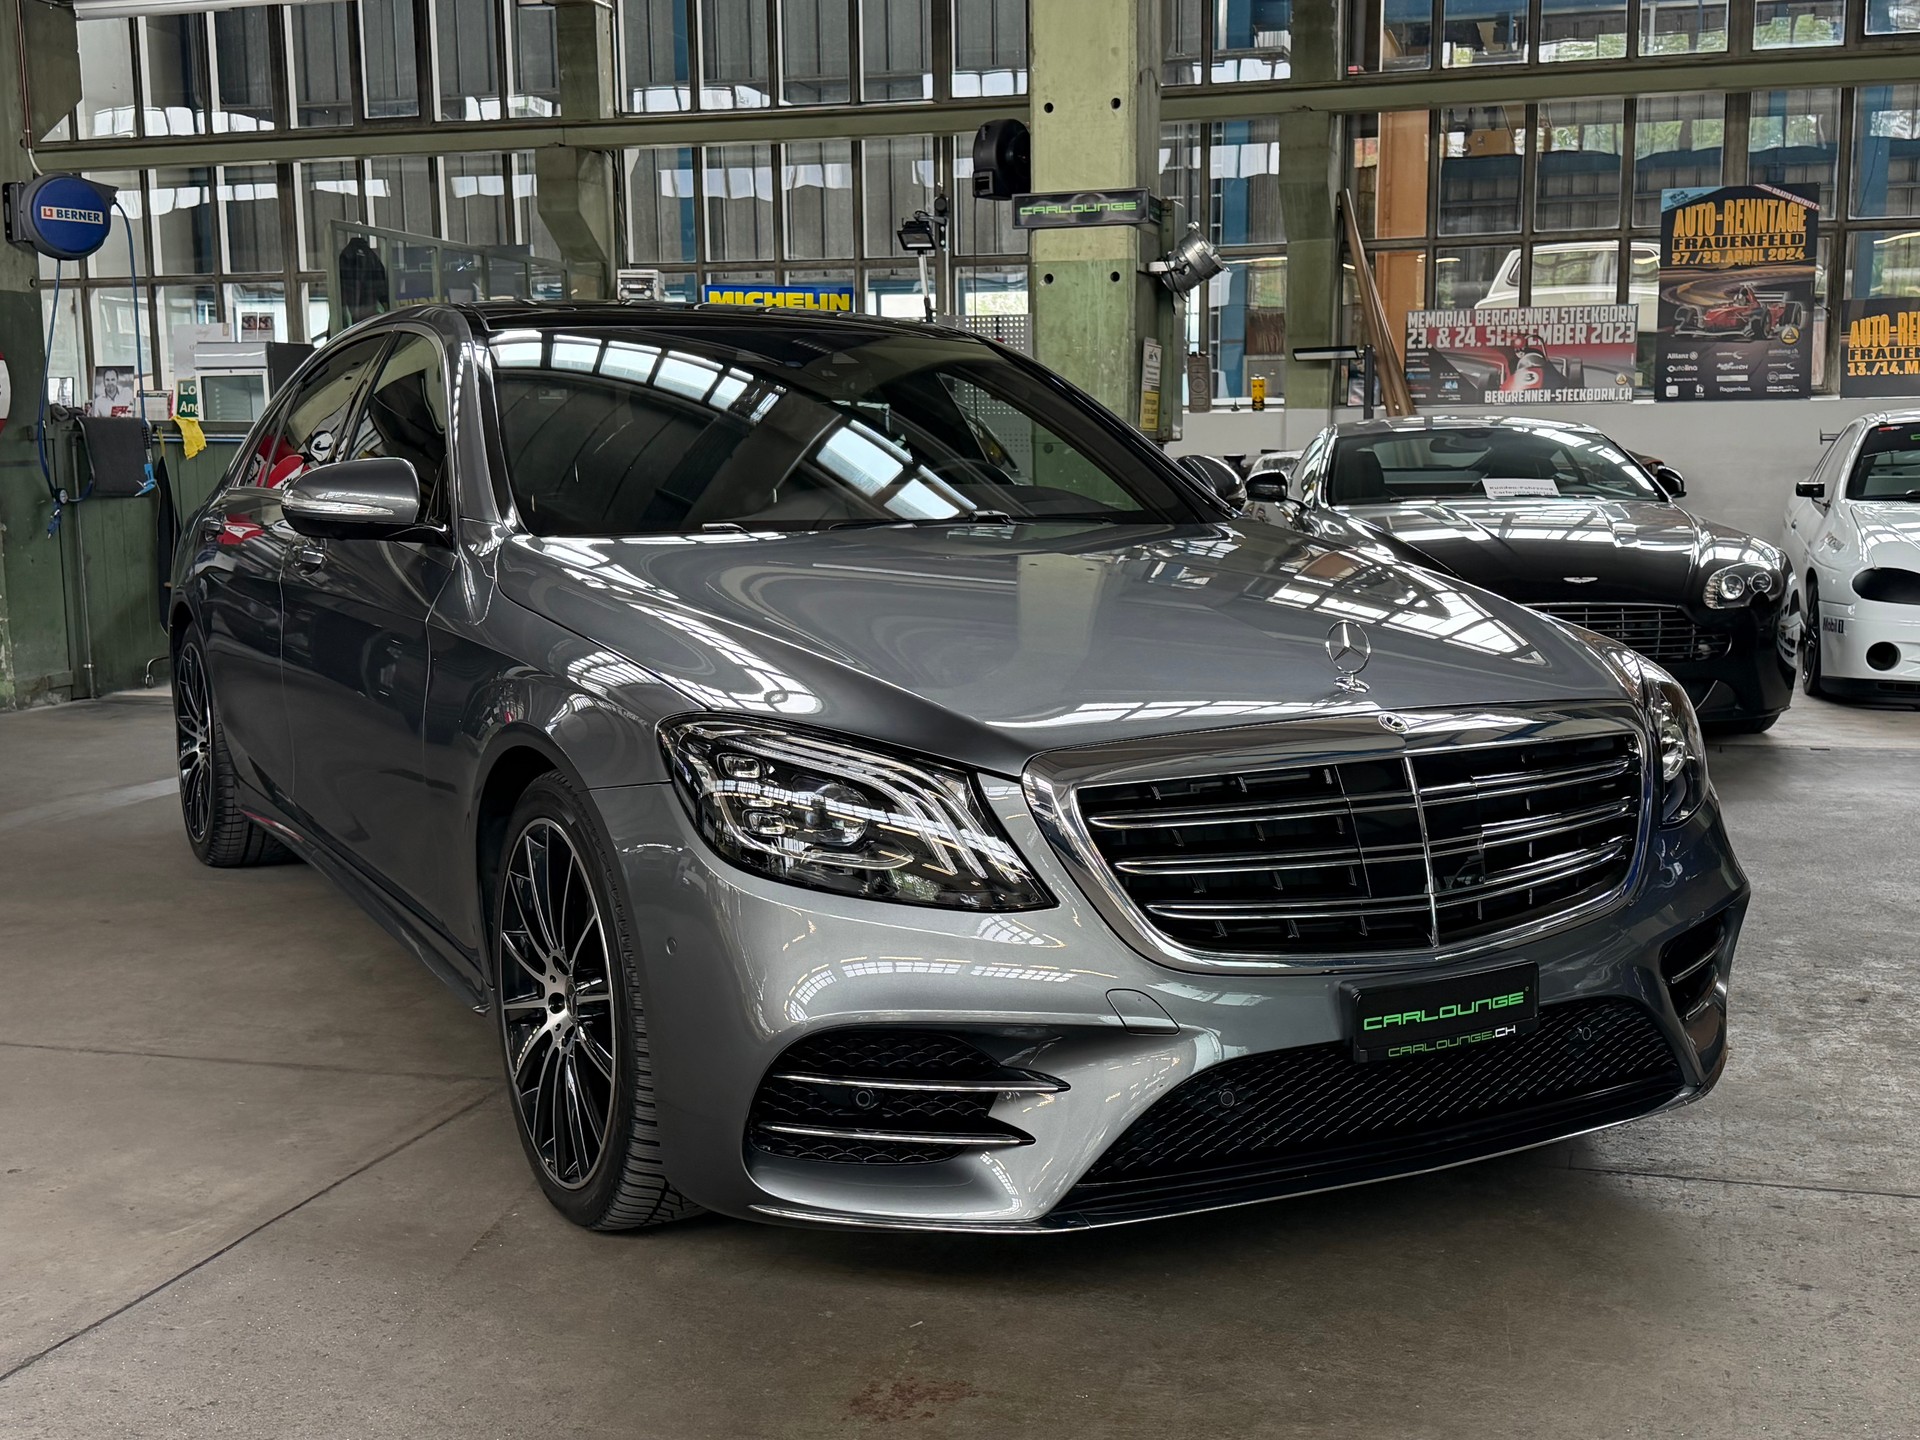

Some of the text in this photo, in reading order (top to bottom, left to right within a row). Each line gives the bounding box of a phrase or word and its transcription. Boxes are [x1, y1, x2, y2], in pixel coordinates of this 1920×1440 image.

[56, 209, 101, 222] BERNER
[1019, 201, 1137, 216] CARLOUNGE
[1673, 199, 1807, 237] AUTO-RENNTAGE
[1673, 233, 1805, 251] FRAUENFELD
[1768, 247, 1805, 262] 2024
[708, 291, 850, 311] MICHELIN
[1407, 305, 1636, 328] MEMORIAL BERGRENNEN STECKBORN
[1407, 322, 1635, 349] 23. & 24. SEPTEMBER 2023
[1849, 311, 1920, 348] AUTO-RE
[1667, 352, 1689, 360] Allianz
[1847, 361, 1920, 376] 13./14.M
[1484, 387, 1633, 403] BERGRENNEN-STECKBORN.CH
[1823, 617, 1837, 632] Mobil
[1363, 991, 1524, 1031] CARLOUNGE
[1388, 1024, 1517, 1058] CARLOUNGE.CH
